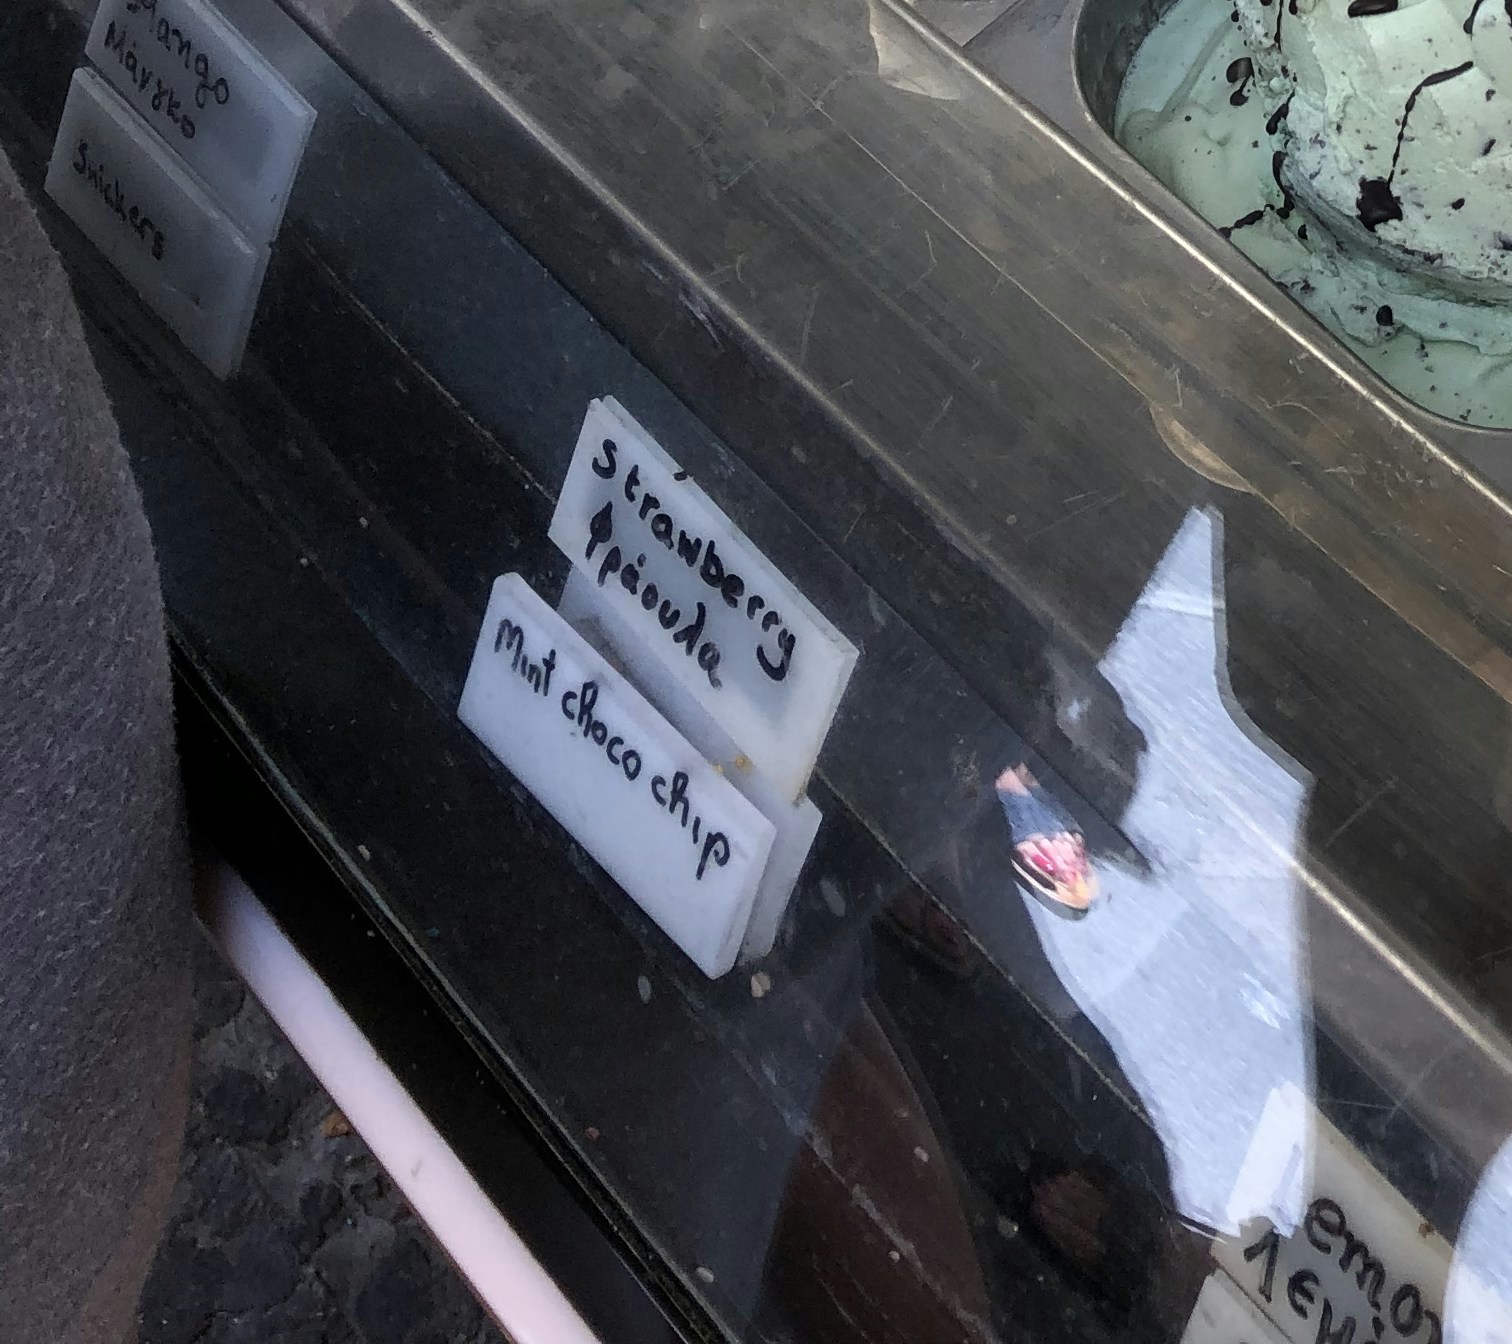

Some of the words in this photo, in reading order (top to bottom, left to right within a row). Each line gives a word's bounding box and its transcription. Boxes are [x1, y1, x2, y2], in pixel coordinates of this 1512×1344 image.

[73, 138, 166, 262] Snickers
[592, 438, 797, 682] Strawberry
[494, 618, 557, 698] Mint
[650, 770, 732, 881] chip
